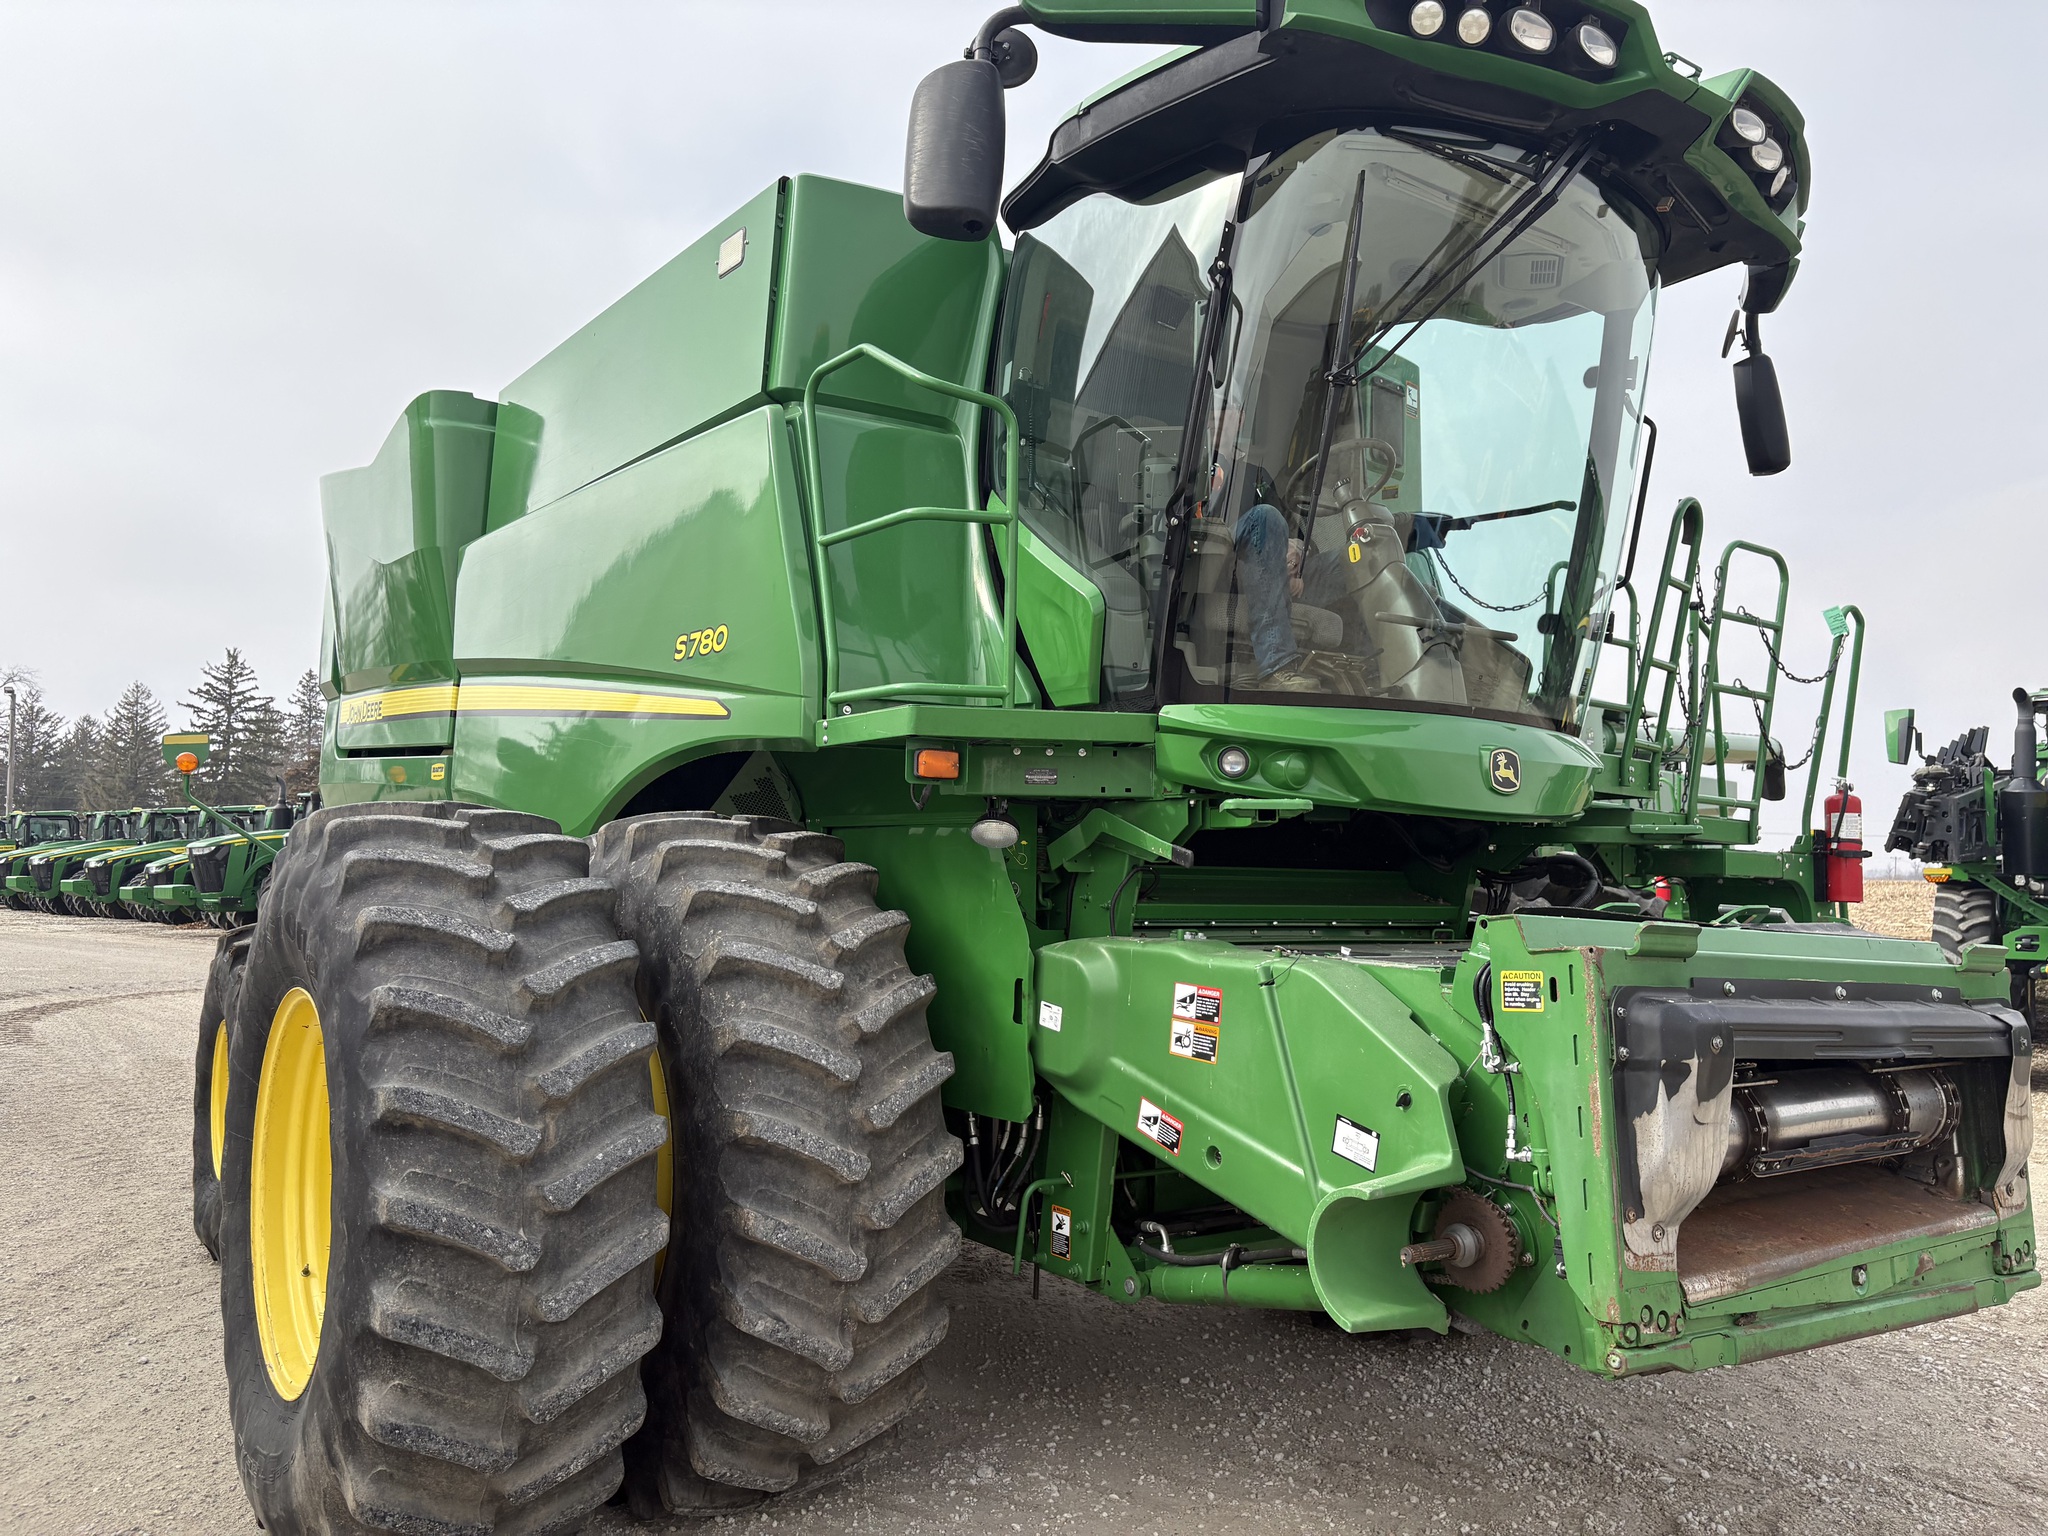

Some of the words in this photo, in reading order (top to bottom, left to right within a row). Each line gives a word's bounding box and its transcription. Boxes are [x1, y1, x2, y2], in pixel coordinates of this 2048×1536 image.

[674, 624, 728, 661] S780
[1202, 989, 1220, 997] DANGER
[1198, 1027, 1217, 1035] WARNING
